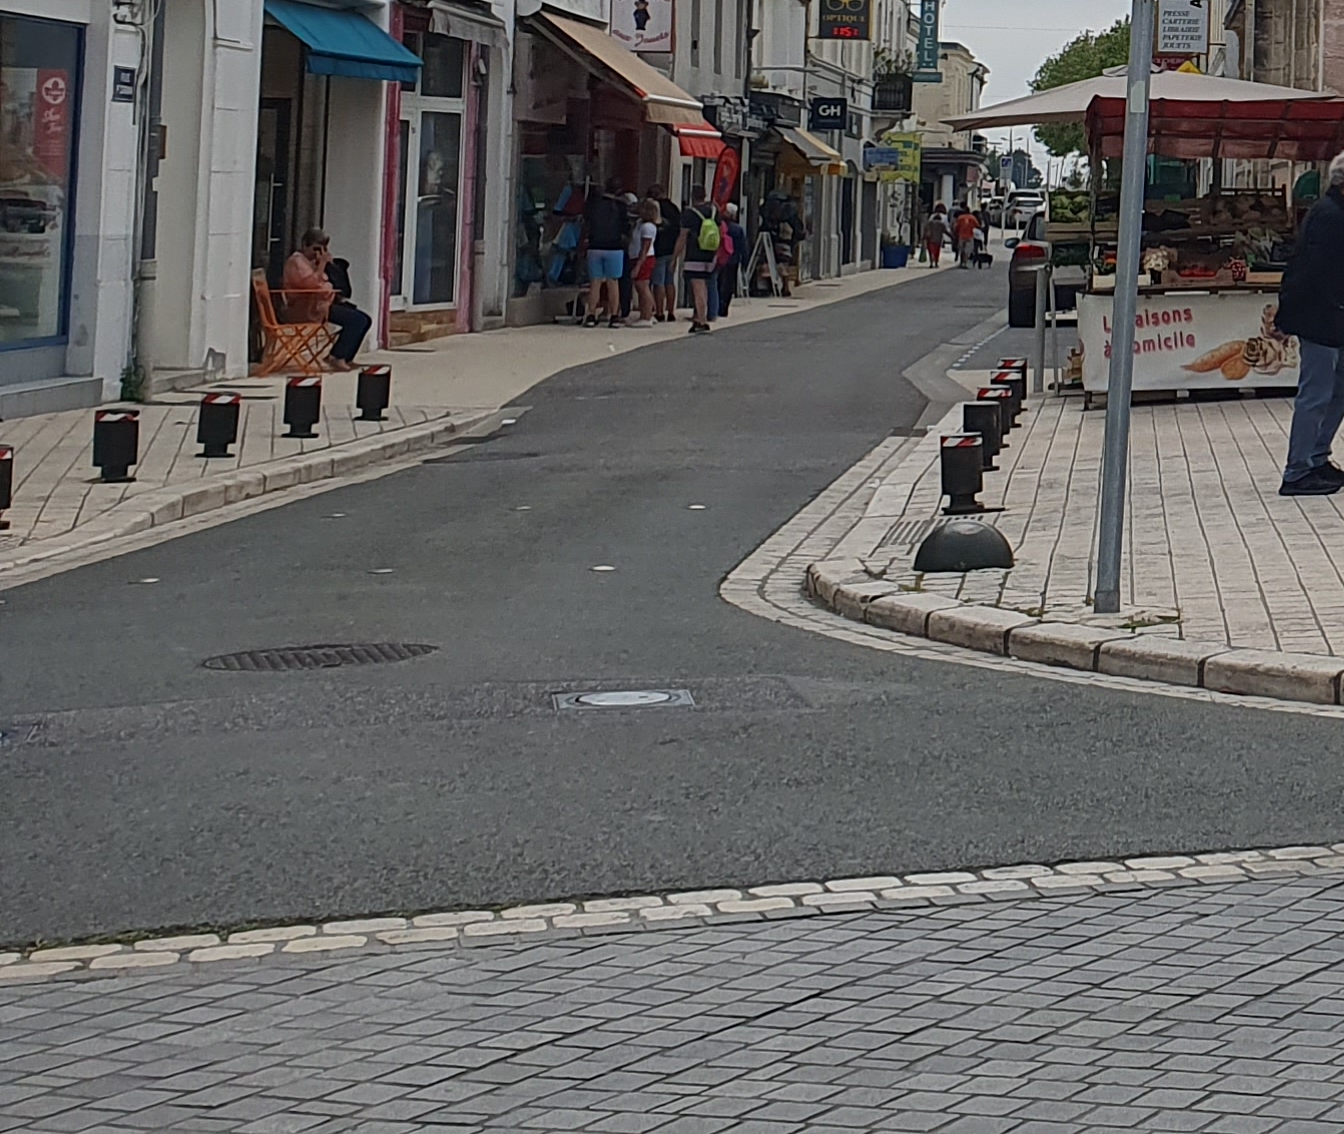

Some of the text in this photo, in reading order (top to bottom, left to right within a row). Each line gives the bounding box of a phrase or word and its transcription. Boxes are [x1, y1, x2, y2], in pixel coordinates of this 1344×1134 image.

[823, 14, 866, 23] OPTIQUE
[923, 1, 935, 62] HOTEL
[818, 104, 841, 117] GH
[1103, 308, 1192, 333] Laisons
[1133, 331, 1195, 354] omicile
